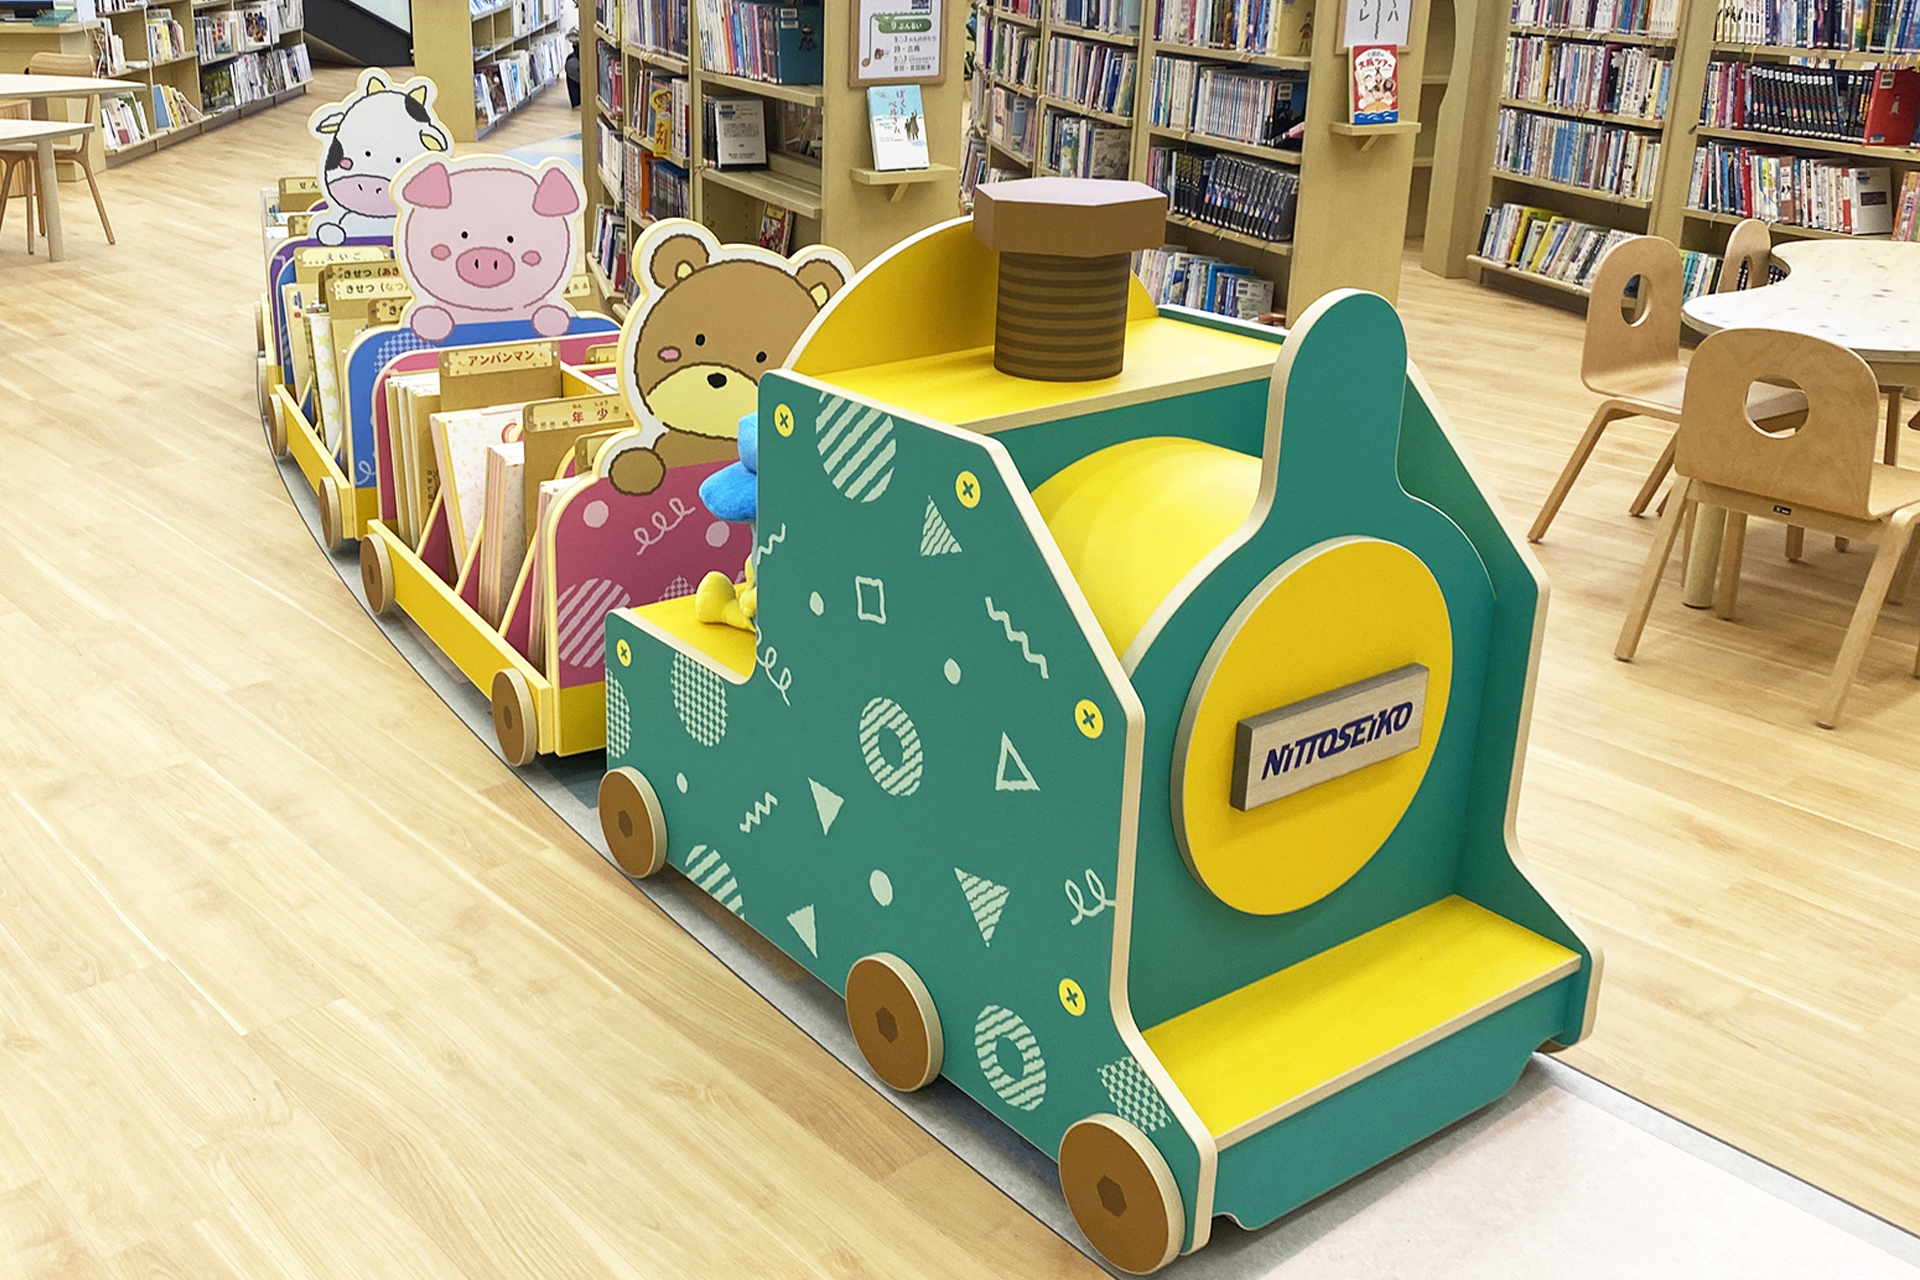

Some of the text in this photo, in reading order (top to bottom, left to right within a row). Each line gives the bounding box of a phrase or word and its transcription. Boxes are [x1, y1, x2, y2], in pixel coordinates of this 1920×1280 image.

[326, 253, 361, 261] えいご
[468, 350, 535, 366] アンパンマン
